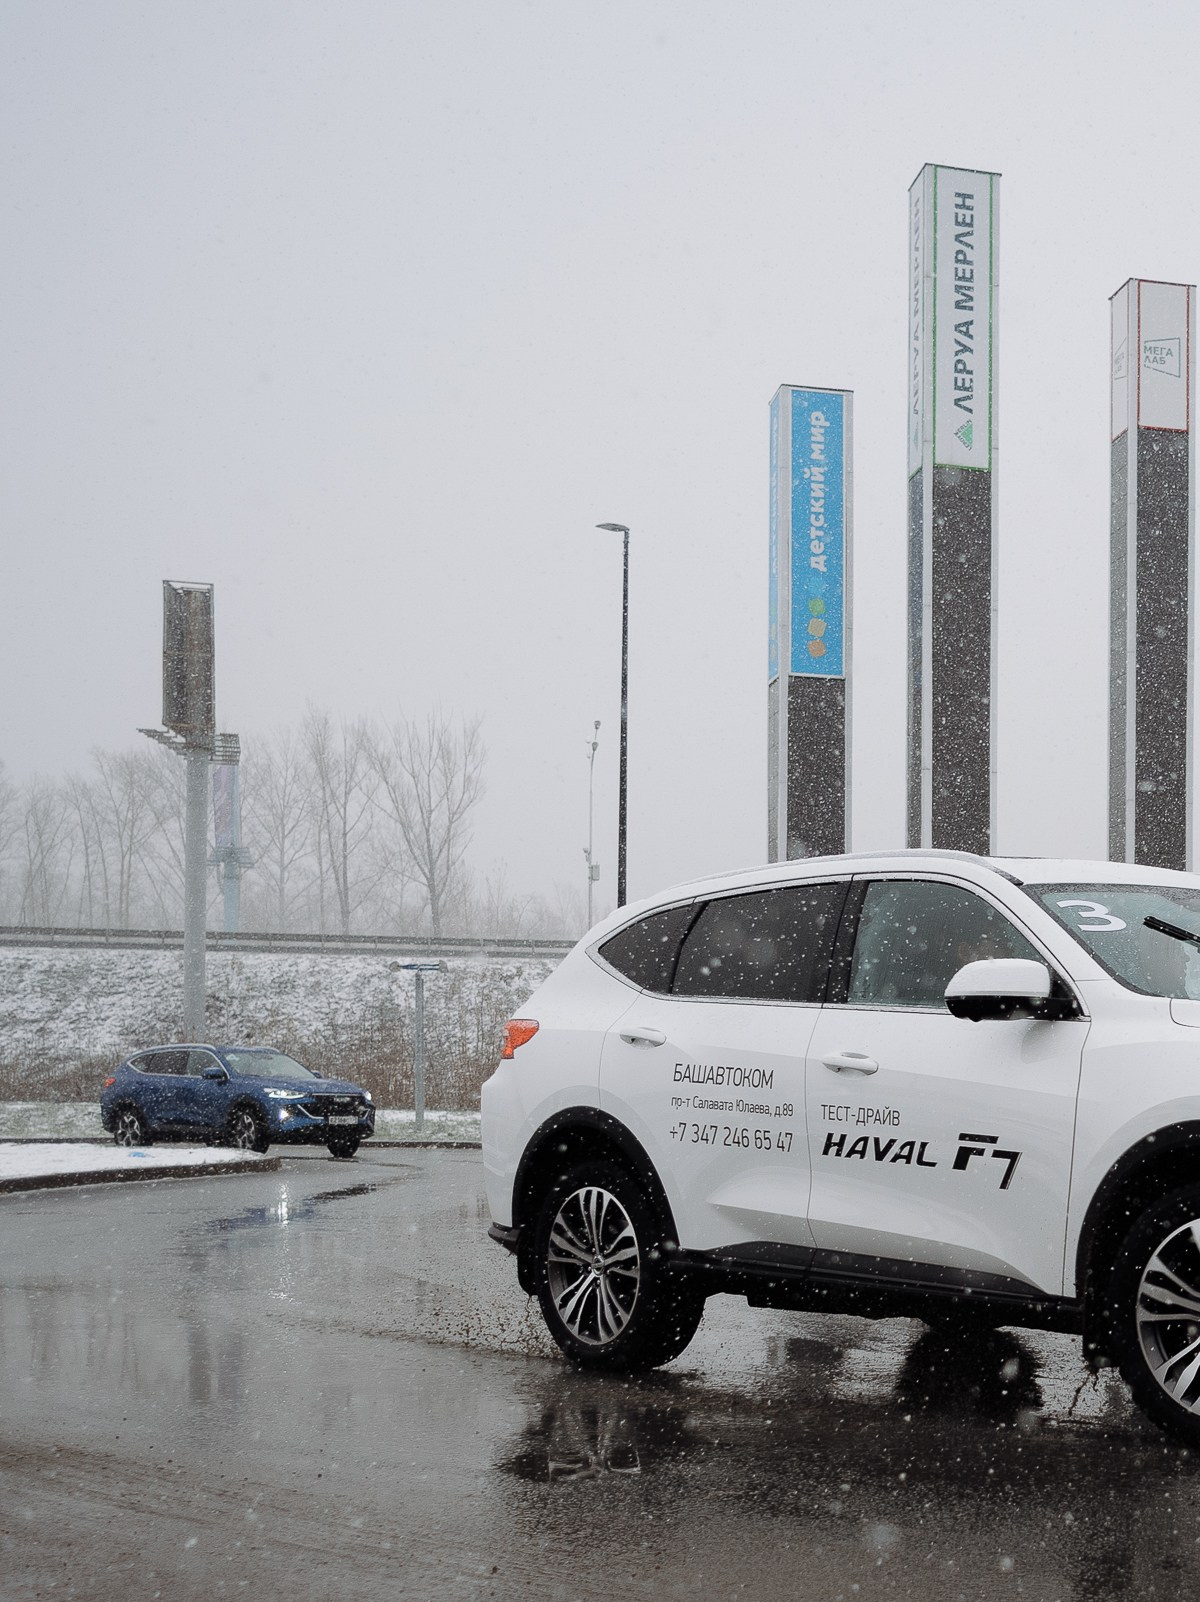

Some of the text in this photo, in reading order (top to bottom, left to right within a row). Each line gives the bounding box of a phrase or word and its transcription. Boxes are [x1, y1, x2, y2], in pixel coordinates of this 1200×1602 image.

[953, 191, 975, 415] ЛЕРУА МЕРЛЕН
[1143, 345, 1174, 358] МЕГА
[1143, 355, 1167, 366] ЛАБ
[803, 410, 831, 573] детский мир
[1055, 899, 1128, 933] 3
[672, 1063, 775, 1090] БАШАВТОКОМ
[692, 1095, 734, 1112] Салавата
[735, 1099, 773, 1117] Юлаева,
[773, 1102, 794, 1118] д.89
[821, 1104, 901, 1127] ТЕСТ-ДРАЙВ
[669, 1122, 794, 1153] +7 347 246 65 47
[822, 1132, 1023, 1190] HAVAL F7
